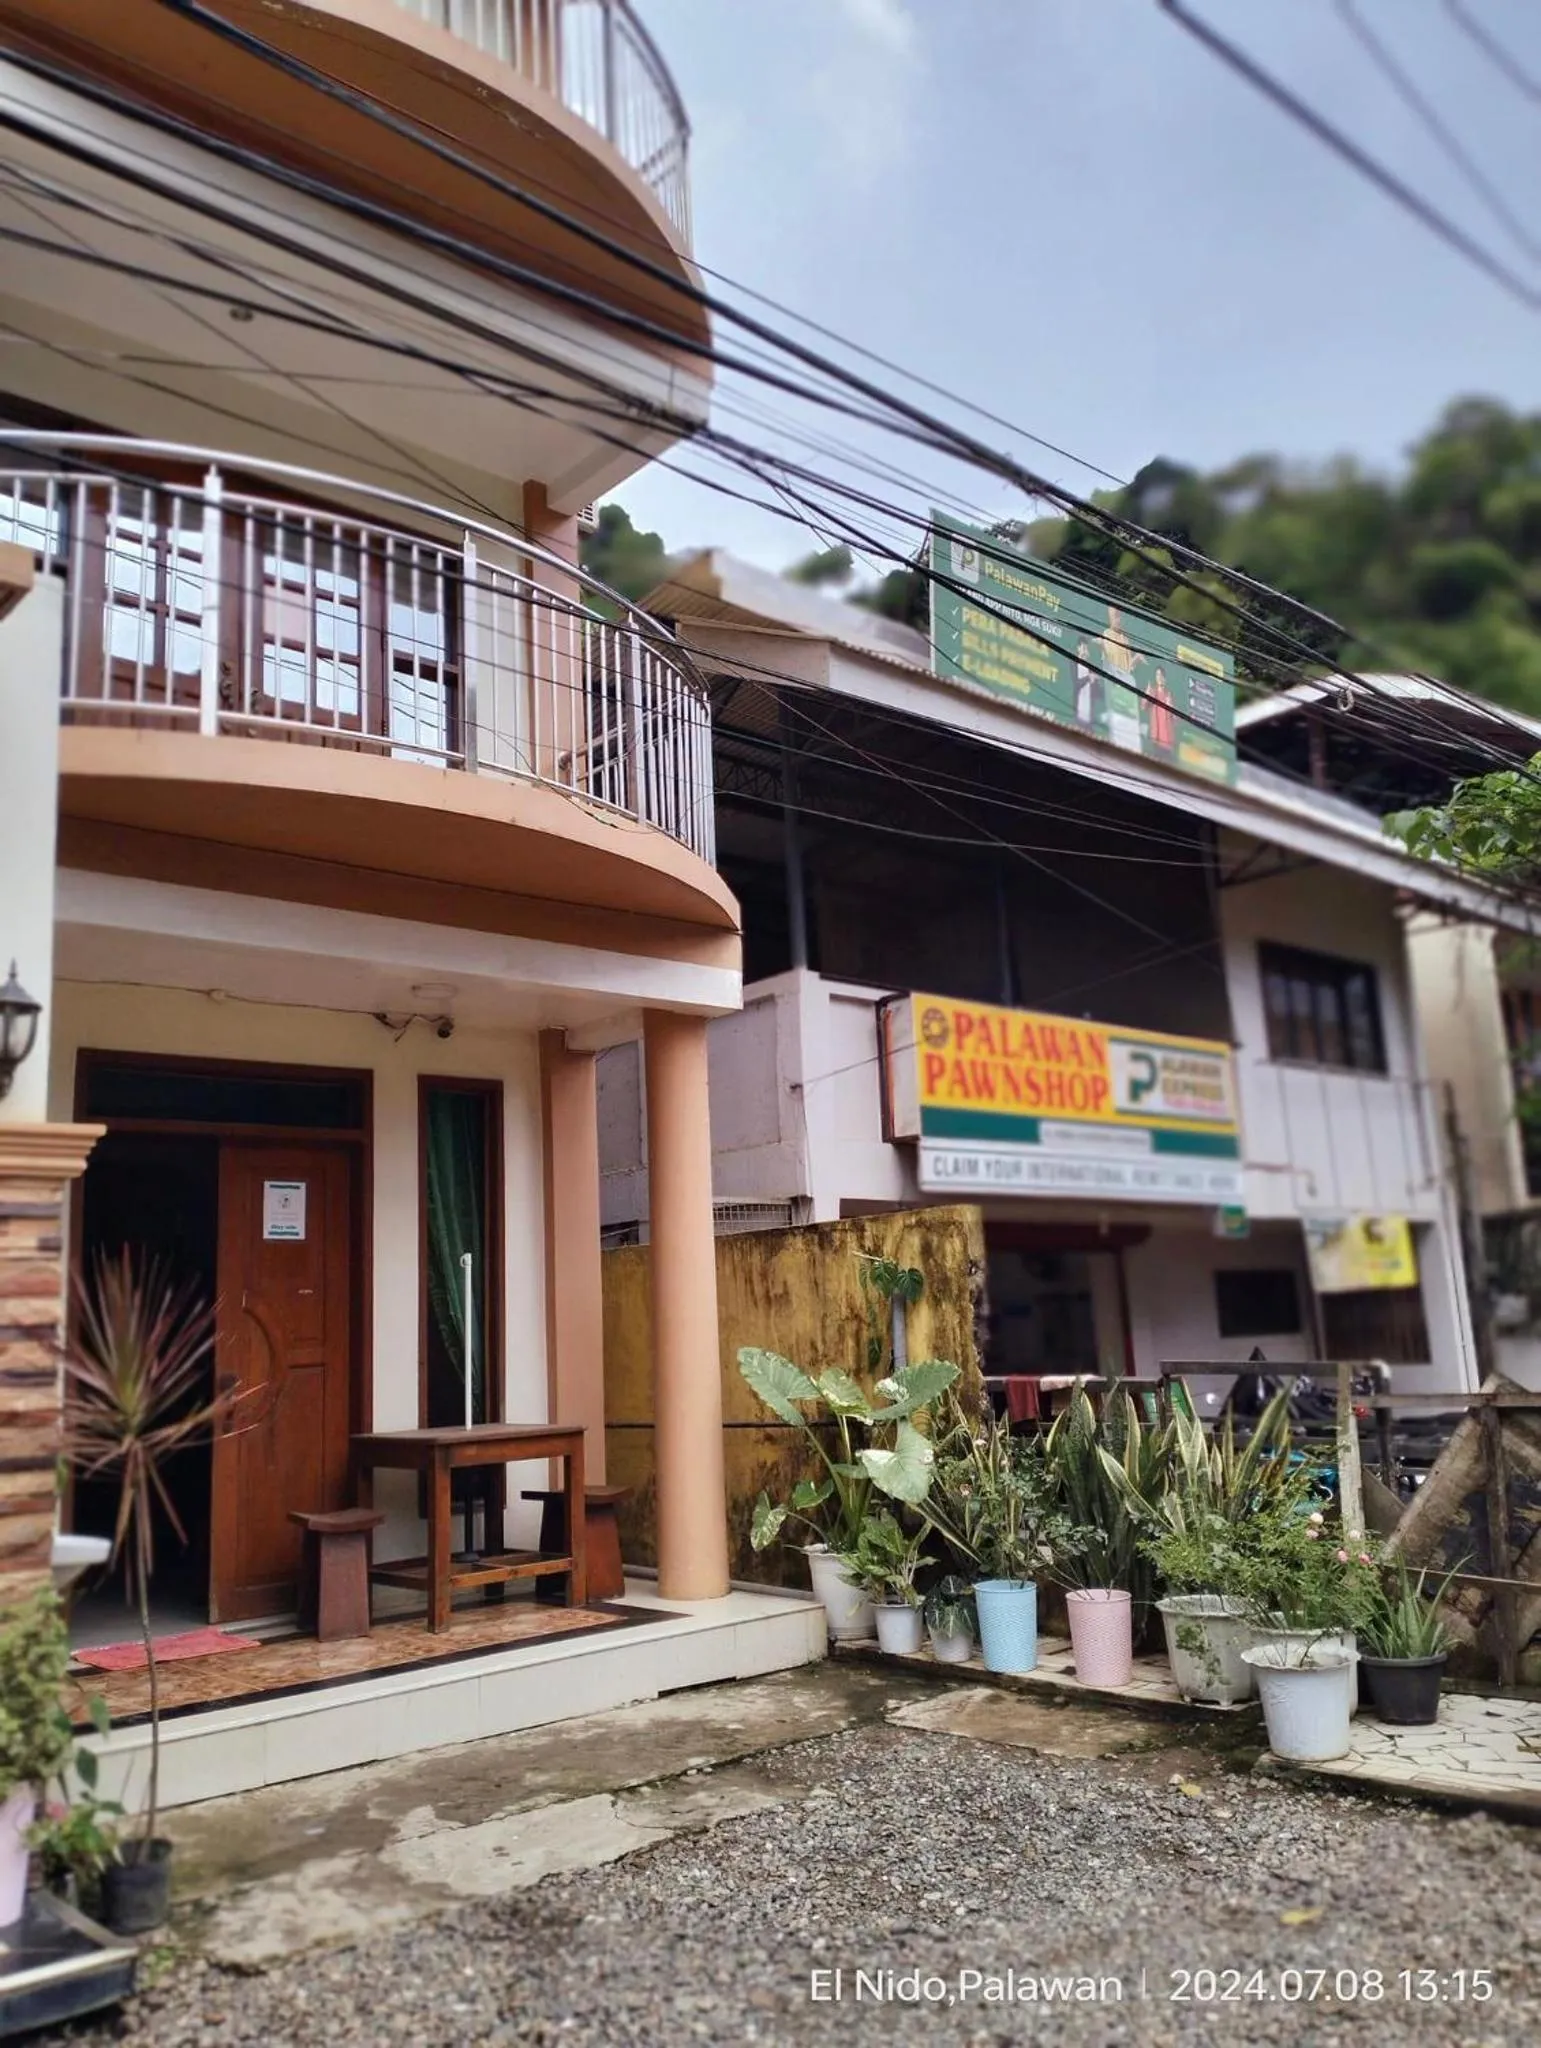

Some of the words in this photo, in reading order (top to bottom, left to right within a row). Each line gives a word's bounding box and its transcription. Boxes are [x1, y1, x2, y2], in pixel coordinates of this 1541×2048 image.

[984, 560, 1061, 613] PalawanPay
[952, 1010, 1106, 1067] PALAWAN
[924, 1052, 1109, 1111] PAWNSHOP
[933, 1155, 980, 1178] CLAIM
[985, 1158, 1023, 1180] YOUR
